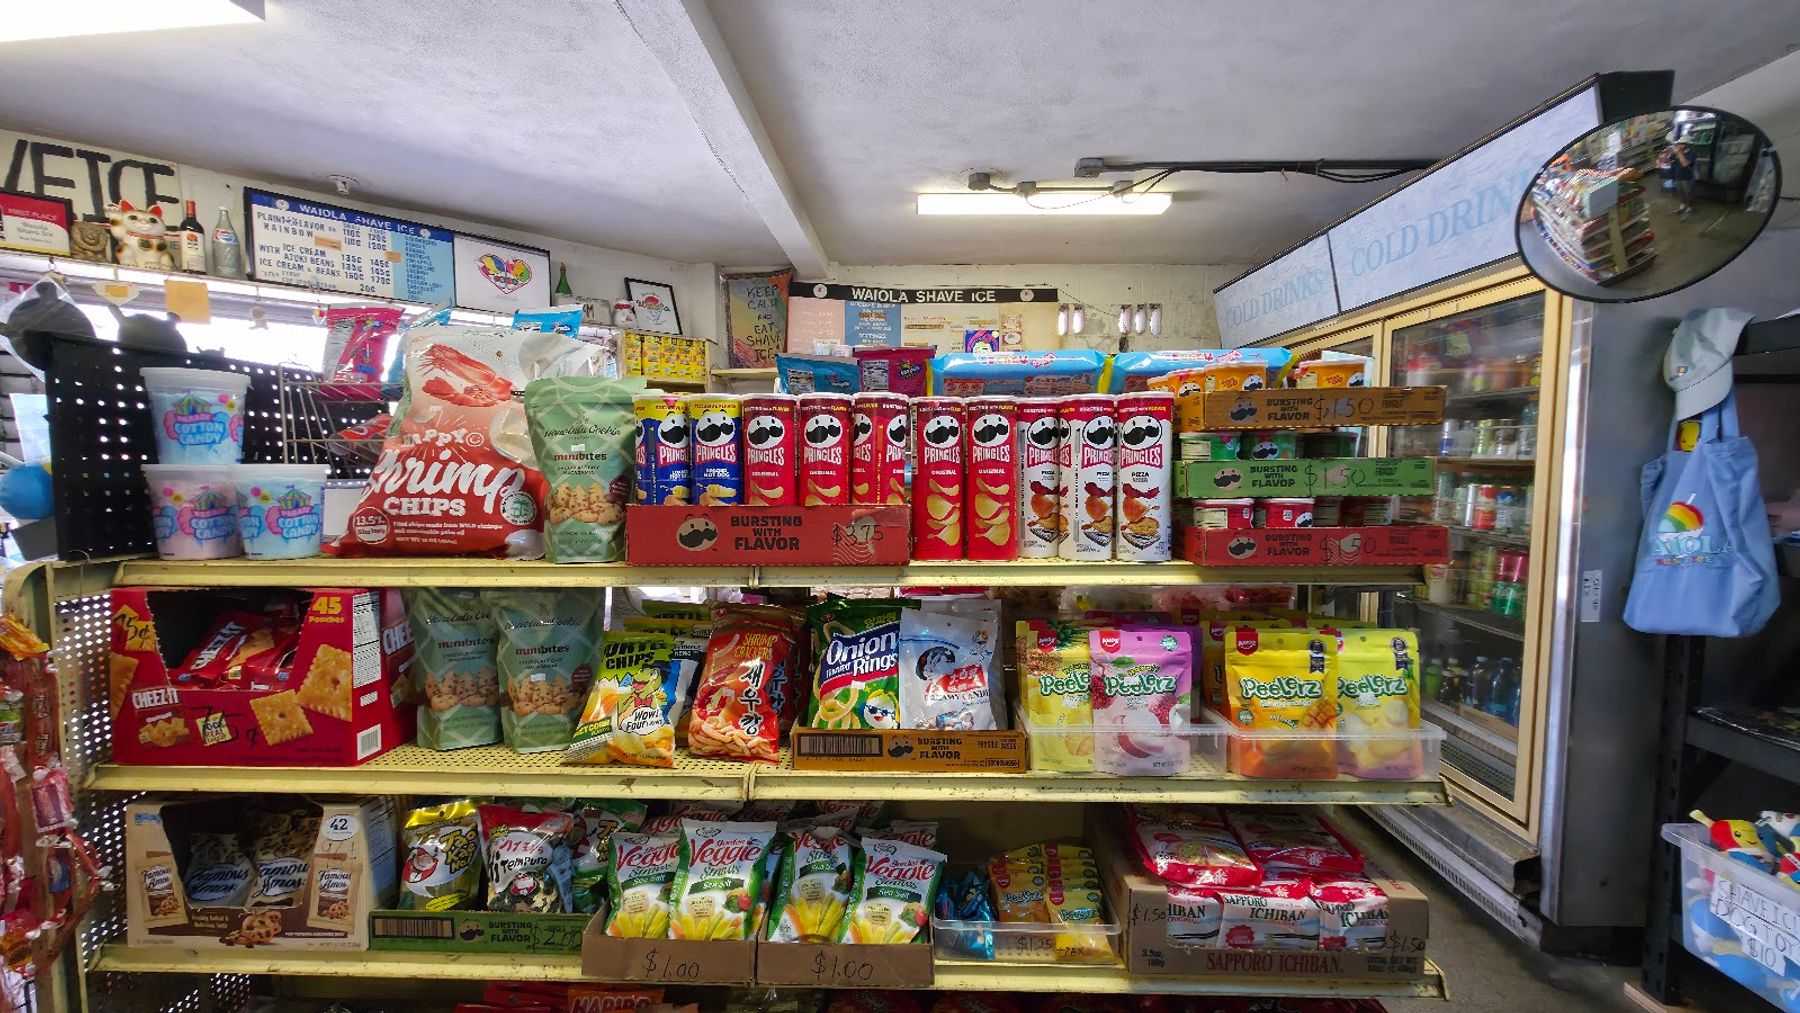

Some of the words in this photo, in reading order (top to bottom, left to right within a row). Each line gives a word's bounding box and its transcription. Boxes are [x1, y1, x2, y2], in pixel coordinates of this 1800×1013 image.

[299, 203, 347, 221] WAIOLA
[353, 214, 392, 231] SHAVE
[397, 222, 416, 233] ICE
[1349, 221, 1420, 278] COLD
[1425, 170, 1530, 248] DRIN
[263, 222, 314, 238] RAINBOW
[282, 243, 296, 252] ICE
[299, 245, 327, 258] CREAM
[259, 258, 273, 267] ICE
[275, 260, 305, 272] CREAM
[315, 266, 341, 277] BEANS
[310, 255, 335, 268] BEANS
[746, 283, 778, 298] KEEP
[851, 287, 909, 303] WAIOLA
[916, 290, 964, 303] SHAVE
[971, 290, 997, 302] ICE
[1224, 295, 1260, 329] COLD
[1262, 266, 1327, 316] DRINKS
[757, 313, 773, 321] AND
[754, 321, 775, 335] EAT
[746, 330, 782, 347] SHAVE
[754, 347, 776, 363] ICE
[1266, 397, 1314, 407] BURSTING
[1267, 412, 1310, 422] FLAVOR
[174, 422, 223, 432] COTTON
[543, 423, 588, 438] Honolulu
[179, 434, 220, 445] CANDY
[553, 451, 608, 461] minibites
[696, 443, 737, 463] PRINGLES
[747, 446, 785, 466] PRINGLES
[803, 446, 843, 465] PRINGLES
[924, 446, 961, 465] PRINGLES
[972, 444, 1011, 464] PRINGLES
[1120, 446, 1162, 467] PRINGLES
[1249, 465, 1298, 473] BURSTING
[383, 496, 467, 517] CHIPS
[278, 515, 318, 527] COTTON
[355, 516, 385, 527] 13.5%
[730, 515, 803, 527] BURSTING
[282, 527, 316, 538] CANDY
[753, 527, 782, 537] WITH
[734, 537, 800, 551] FLAVOR
[1266, 547, 1310, 556] FLAVOR
[312, 596, 343, 615] 45
[308, 616, 345, 624] Pouches
[437, 636, 496, 650] minibites
[742, 633, 778, 647] SHRIMP
[515, 643, 570, 656] minibites
[734, 645, 774, 661] CRACKERS
[825, 631, 897, 666] Onion
[605, 651, 655, 670] CHIPS
[852, 652, 899, 677] Rings
[1040, 671, 1090, 696] Peele
[1240, 675, 1323, 700] Peelerz
[737, 660, 766, 737] 새우깡
[633, 707, 660, 722] WOW!
[917, 737, 963, 745] BURSTING
[919, 750, 961, 760] FLAVOR
[329, 818, 349, 832] 42
[438, 827, 479, 850] Tao
[445, 843, 478, 864] Kae
[689, 837, 763, 869] Veggie
[143, 866, 172, 880] Famous
[449, 859, 473, 875] Noi
[864, 855, 936, 881] Veggie
[146, 876, 170, 891] Amos
[318, 869, 352, 884] Famous
[319, 879, 348, 889] Amos
[1223, 892, 1268, 907] SAPPORO
[1131, 902, 1167, 927] $1.50
[1249, 906, 1308, 923] ICHIBAN
[488, 921, 533, 929] BURSTING
[490, 934, 531, 942] FLAVOR
[1747, 937, 1776, 968] $10
[641, 947, 700, 980] $1.00
[811, 949, 874, 983] $1.00
[1206, 952, 1273, 973] SAPPORO
